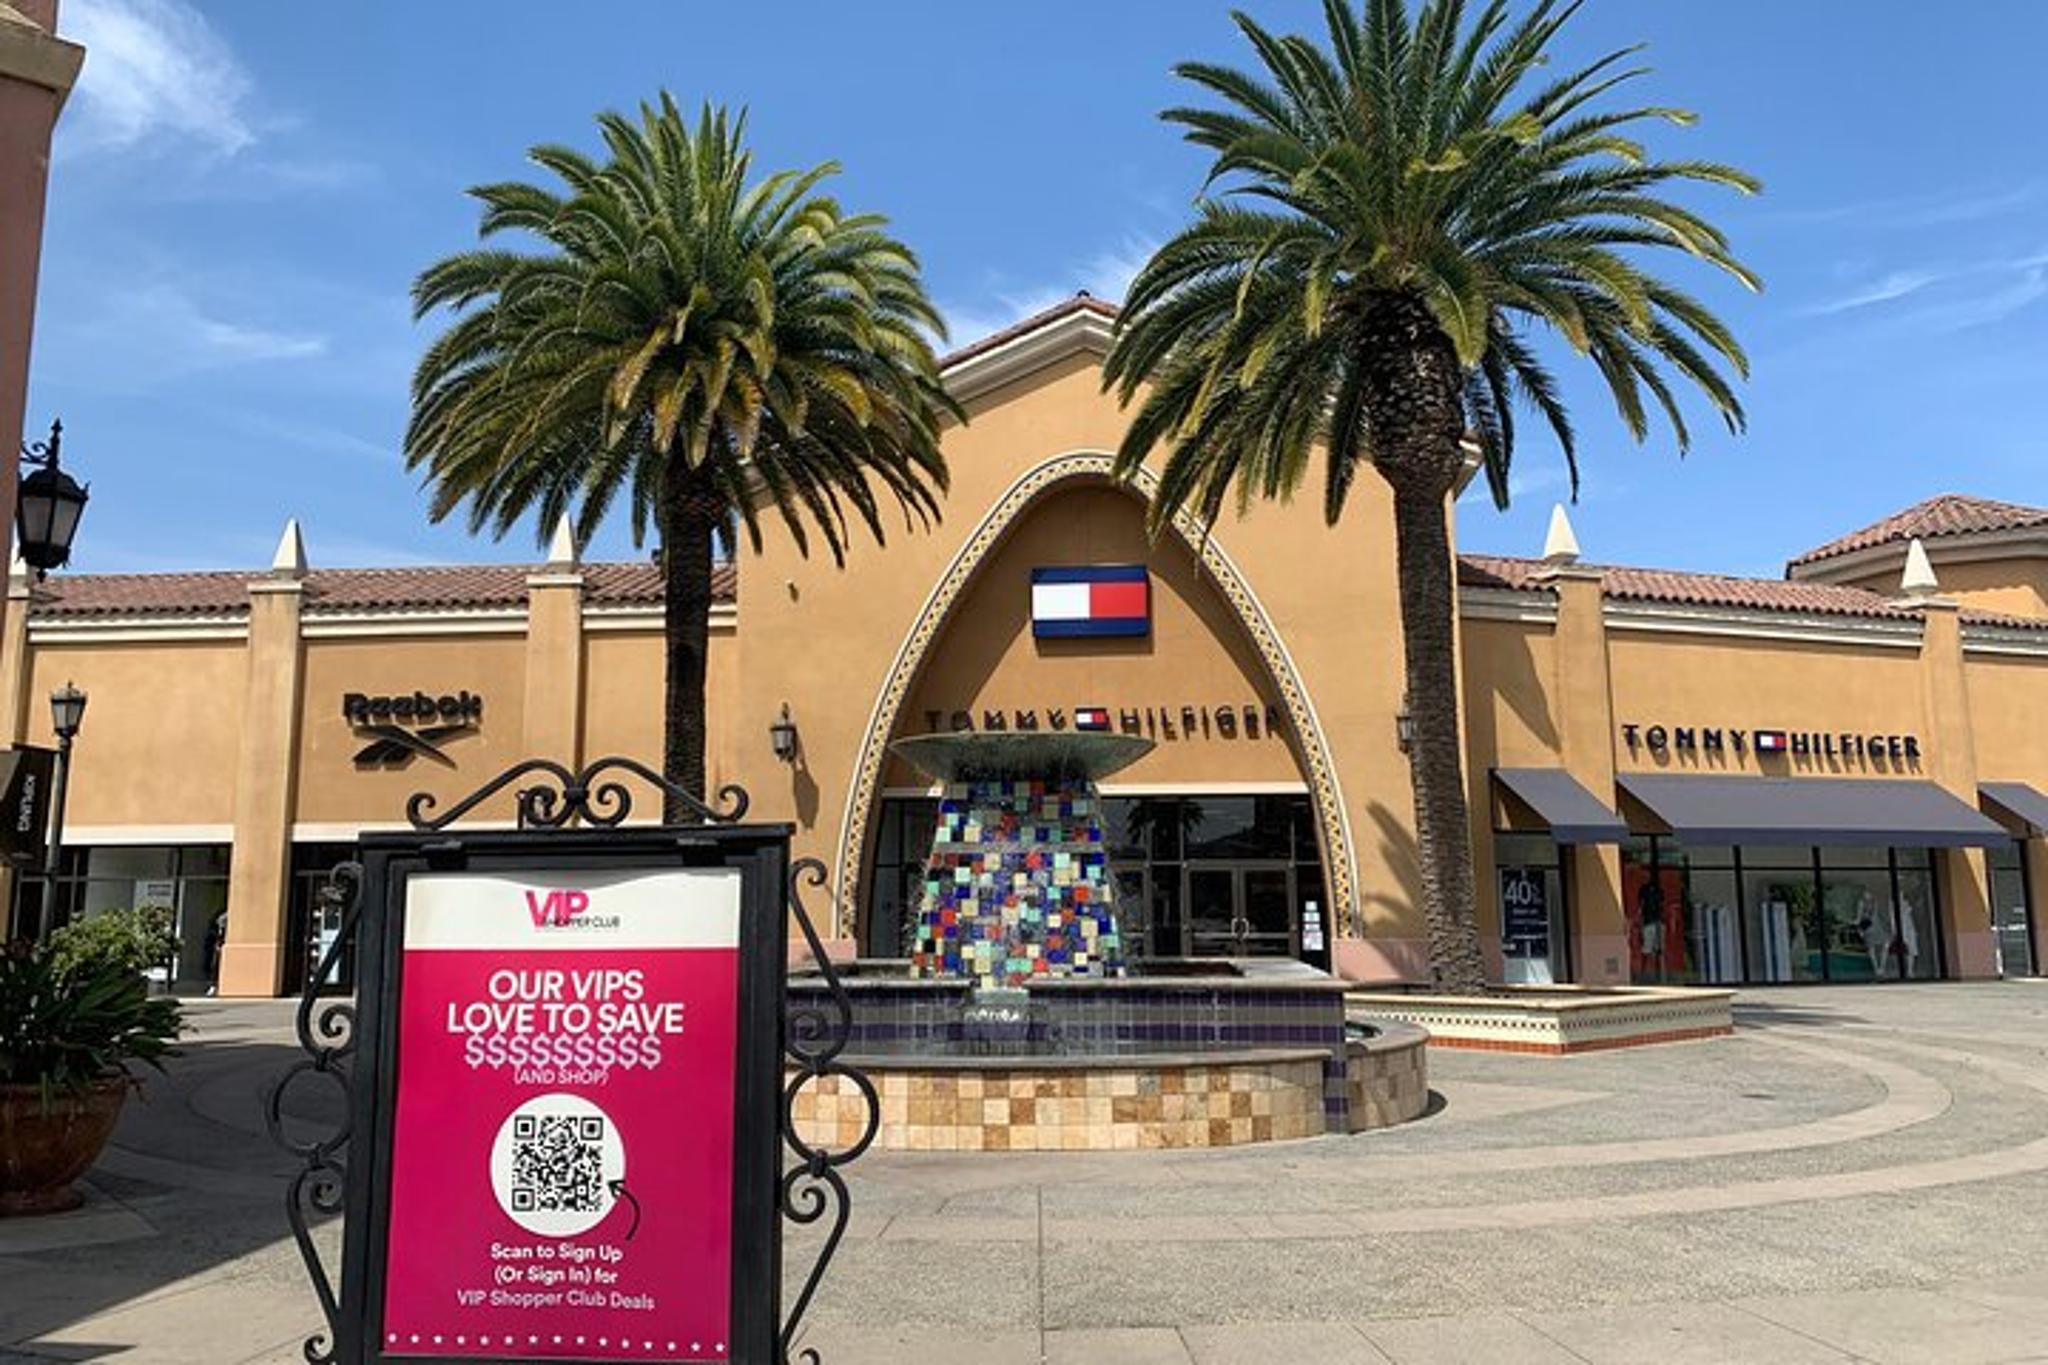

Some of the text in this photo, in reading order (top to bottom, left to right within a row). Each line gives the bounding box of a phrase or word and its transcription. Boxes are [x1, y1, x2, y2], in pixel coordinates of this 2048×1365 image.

[343, 690, 482, 721] Reebok
[925, 706, 1280, 738] TOMMY HILFIGER
[1622, 724, 1921, 757] TOMMY HILFIGER
[525, 889, 589, 927] VIP
[489, 969, 645, 1001] OUR VIPS
[447, 1002, 684, 1033] LOVE TO SAVE
[514, 1069, 609, 1085] (AND SHOP)
[490, 1243, 623, 1263] Scan to Sign Up
[494, 1266, 618, 1285] (Or Sign In) for
[457, 1289, 656, 1311] VIP Shopper Club Deals
